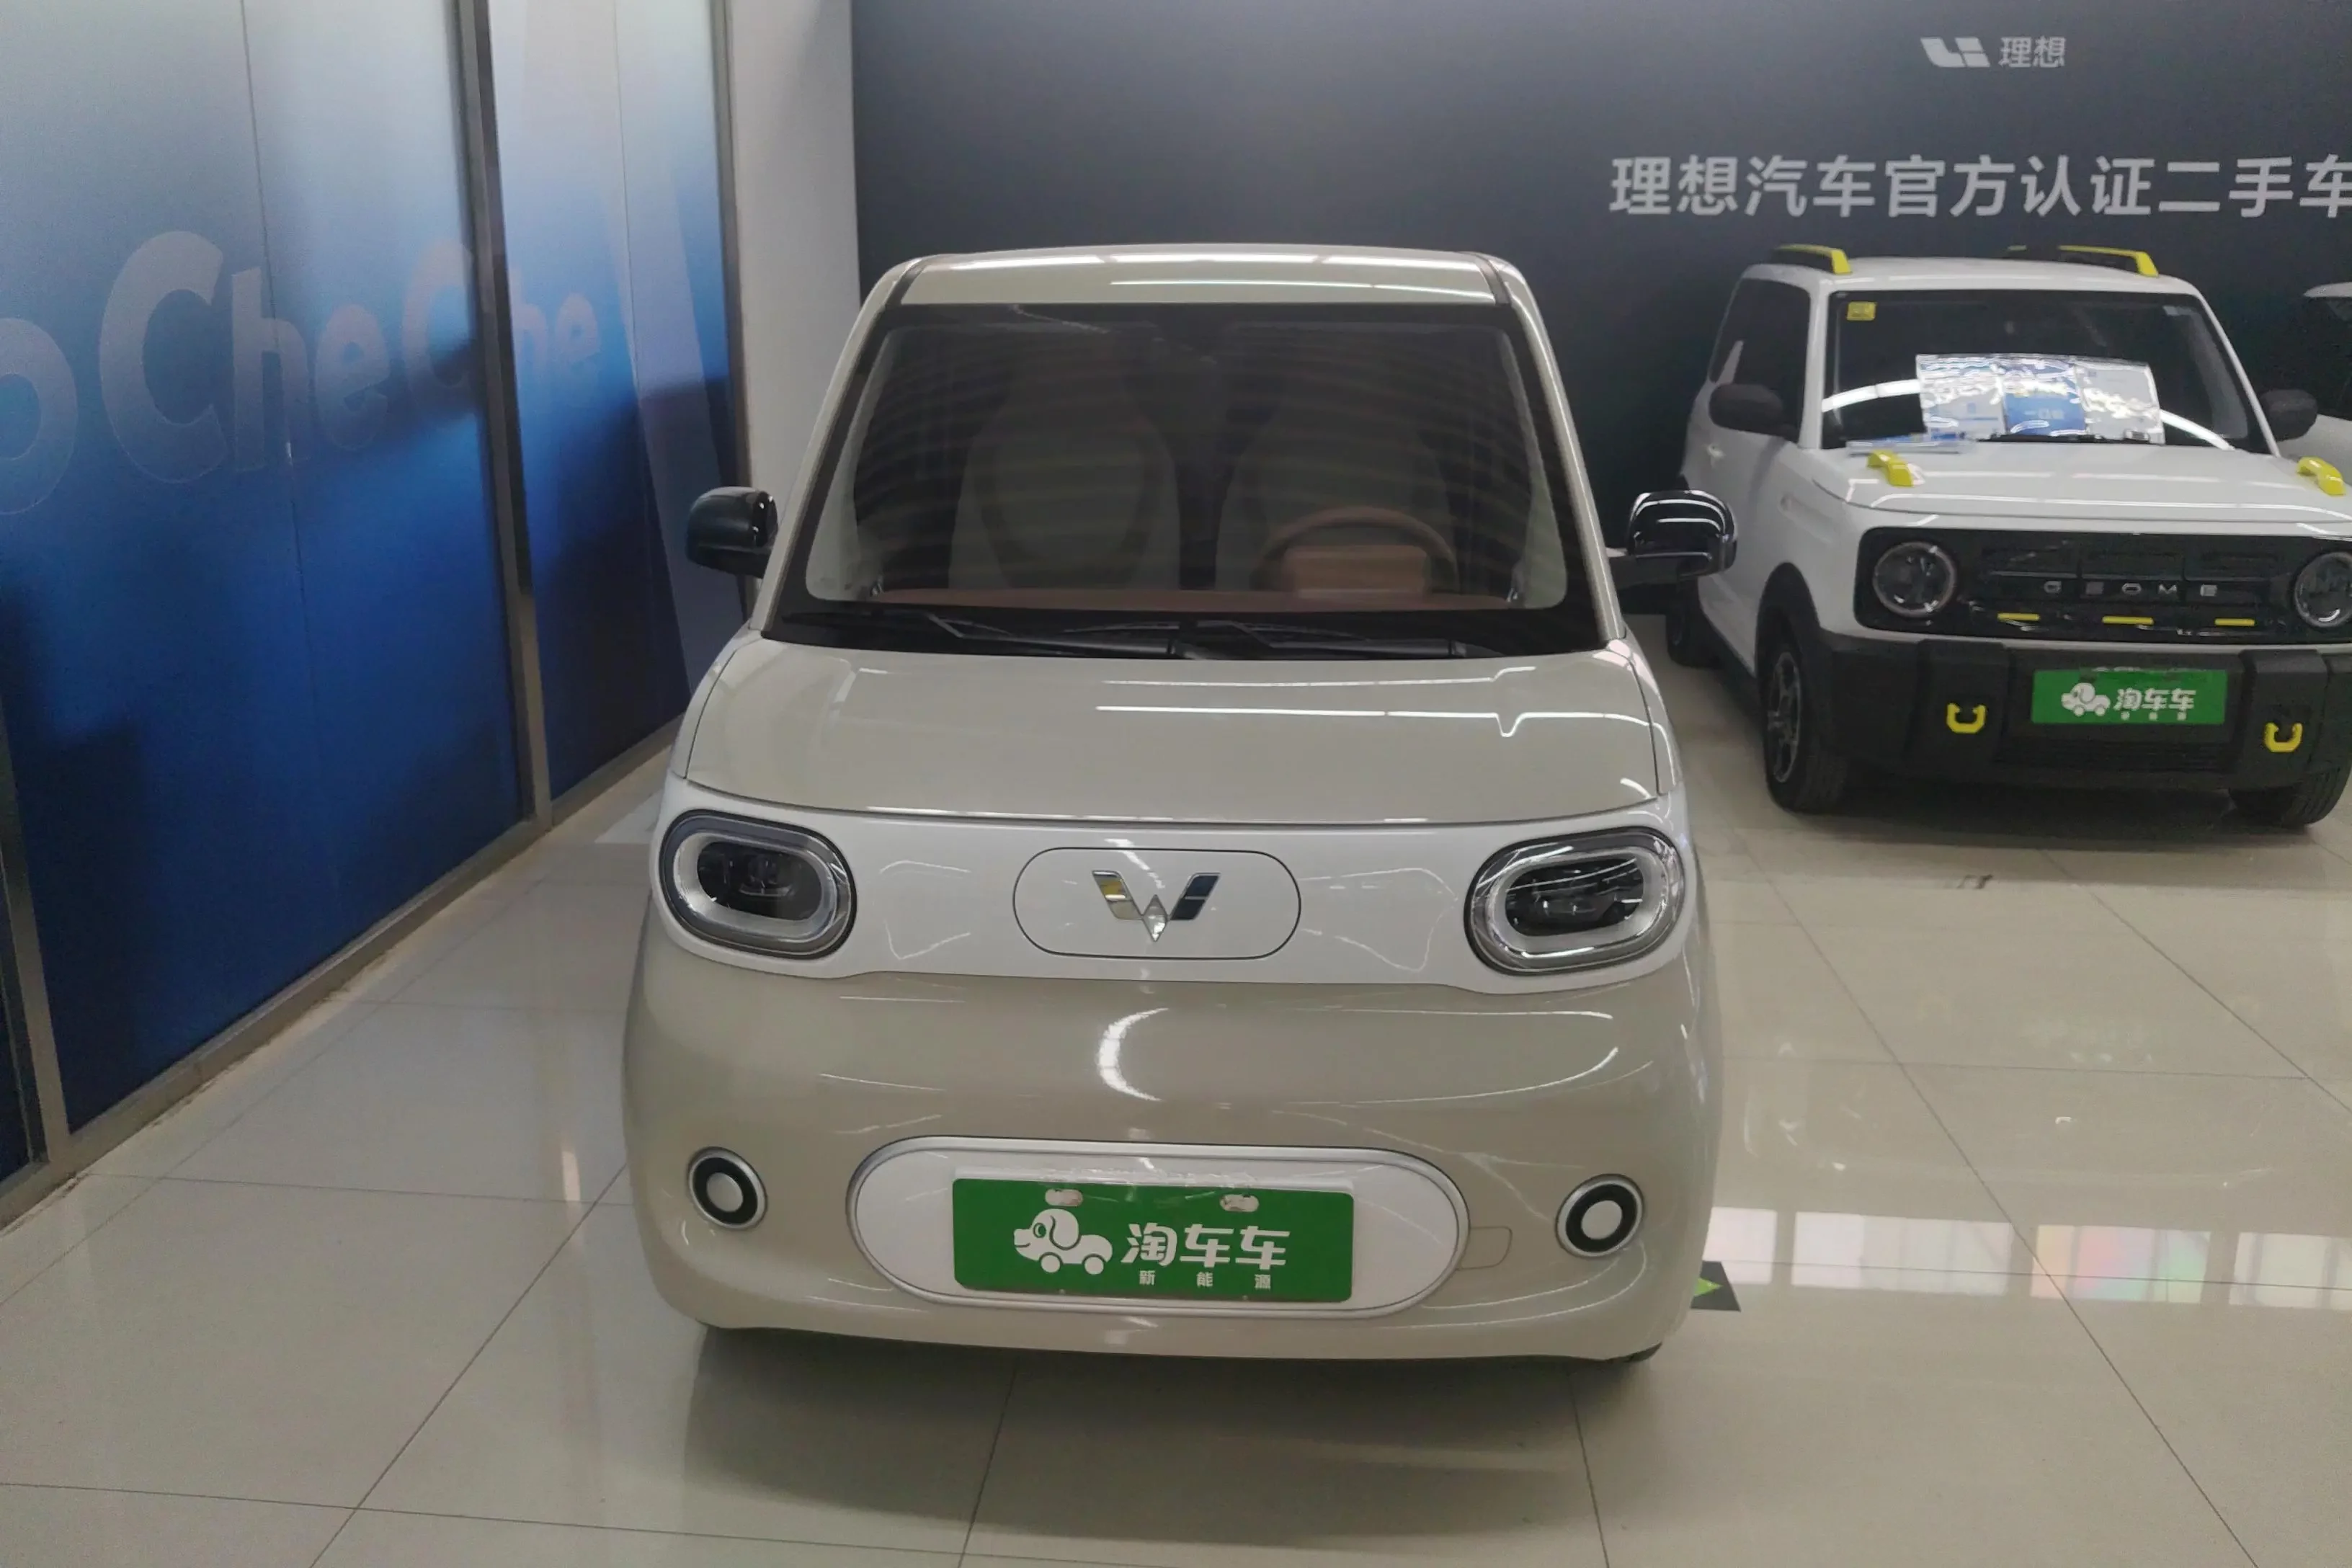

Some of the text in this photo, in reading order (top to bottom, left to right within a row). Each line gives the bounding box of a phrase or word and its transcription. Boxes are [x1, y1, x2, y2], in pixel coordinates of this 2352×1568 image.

[1999, 36, 2067, 68] 理想
[1608, 153, 2352, 219] 理想汽车官方认证二手车
[2113, 687, 2197, 711] 淘车车
[1121, 1222, 1291, 1270] 淘车车
[1139, 1270, 1272, 1289] 新能源
